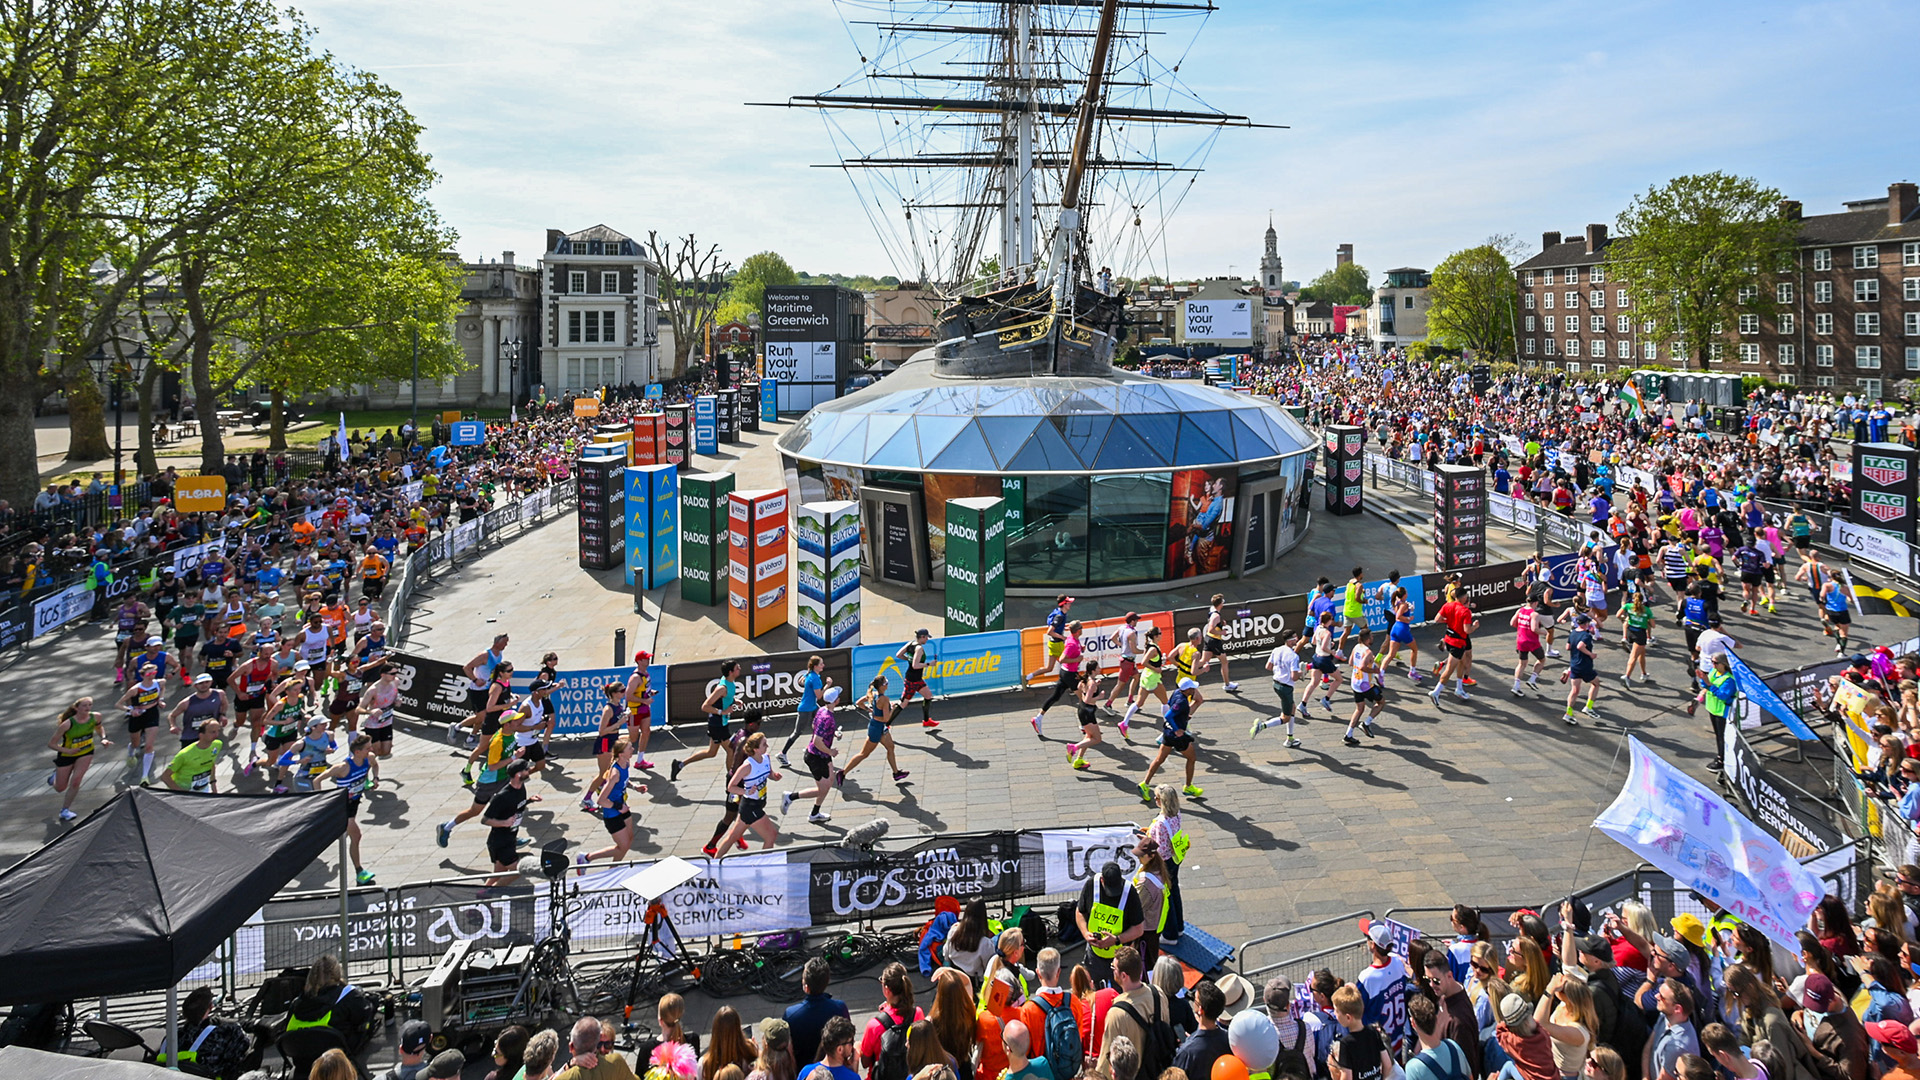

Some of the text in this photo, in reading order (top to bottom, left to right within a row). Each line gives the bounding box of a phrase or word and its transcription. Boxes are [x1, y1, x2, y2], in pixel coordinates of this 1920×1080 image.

[768, 303, 812, 312] Maritime
[1189, 304, 1209, 313] Run
[768, 314, 828, 325] Greenwich
[1189, 315, 1213, 324] your
[1189, 326, 1213, 335] way.
[769, 345, 793, 356] Run
[768, 359, 798, 370] your
[768, 371, 798, 382] way.
[1866, 457, 1902, 470] TAG
[1864, 467, 1905, 484] HEUER
[178, 489, 222, 499] FLORA
[683, 495, 709, 509] RADOX
[1866, 493, 1902, 505] TAG
[1864, 503, 1904, 520] HEUER
[683, 530, 709, 545] RADOX
[800, 527, 823, 545] BUXTON
[832, 526, 857, 544] BUXTON
[948, 522, 978, 542] RADOX
[985, 519, 1004, 541] RADOX
[1840, 526, 1864, 551] tcs
[683, 567, 709, 582] RADOX
[800, 572, 823, 590] BUXTON
[833, 571, 858, 590] BUXTON
[947, 564, 978, 585] RADOX
[985, 560, 1004, 584] RADOX
[106, 576, 130, 598] tcs
[40, 604, 59, 628] tcs
[947, 606, 978, 628] RADOX
[985, 601, 1004, 627] RADOX
[800, 616, 823, 636] BUXTON
[833, 615, 858, 635] BUXTON
[1234, 640, 1249, 651] your
[1249, 636, 1275, 649] progress
[922, 651, 1001, 680] ucozade
[561, 675, 621, 689] ABBOTT
[560, 690, 606, 702] WORL
[427, 702, 442, 712] new
[744, 701, 764, 712] your
[559, 716, 601, 728] MAJO
[1737, 749, 1758, 810] tcs
[1759, 795, 1830, 852] CONSULTANCY
[915, 847, 960, 865] TATA
[915, 860, 1019, 883] CONSULTANCY
[832, 868, 907, 916] tcs
[916, 882, 982, 900] SERVICES
[1691, 878, 1720, 897] AND
[674, 892, 783, 911] CONSULTANCY
[674, 907, 744, 926] SERVICES
[1094, 909, 1105, 921] tcs
[1730, 900, 1794, 943] ARCHIE
[1381, 994, 1406, 1034] 25
